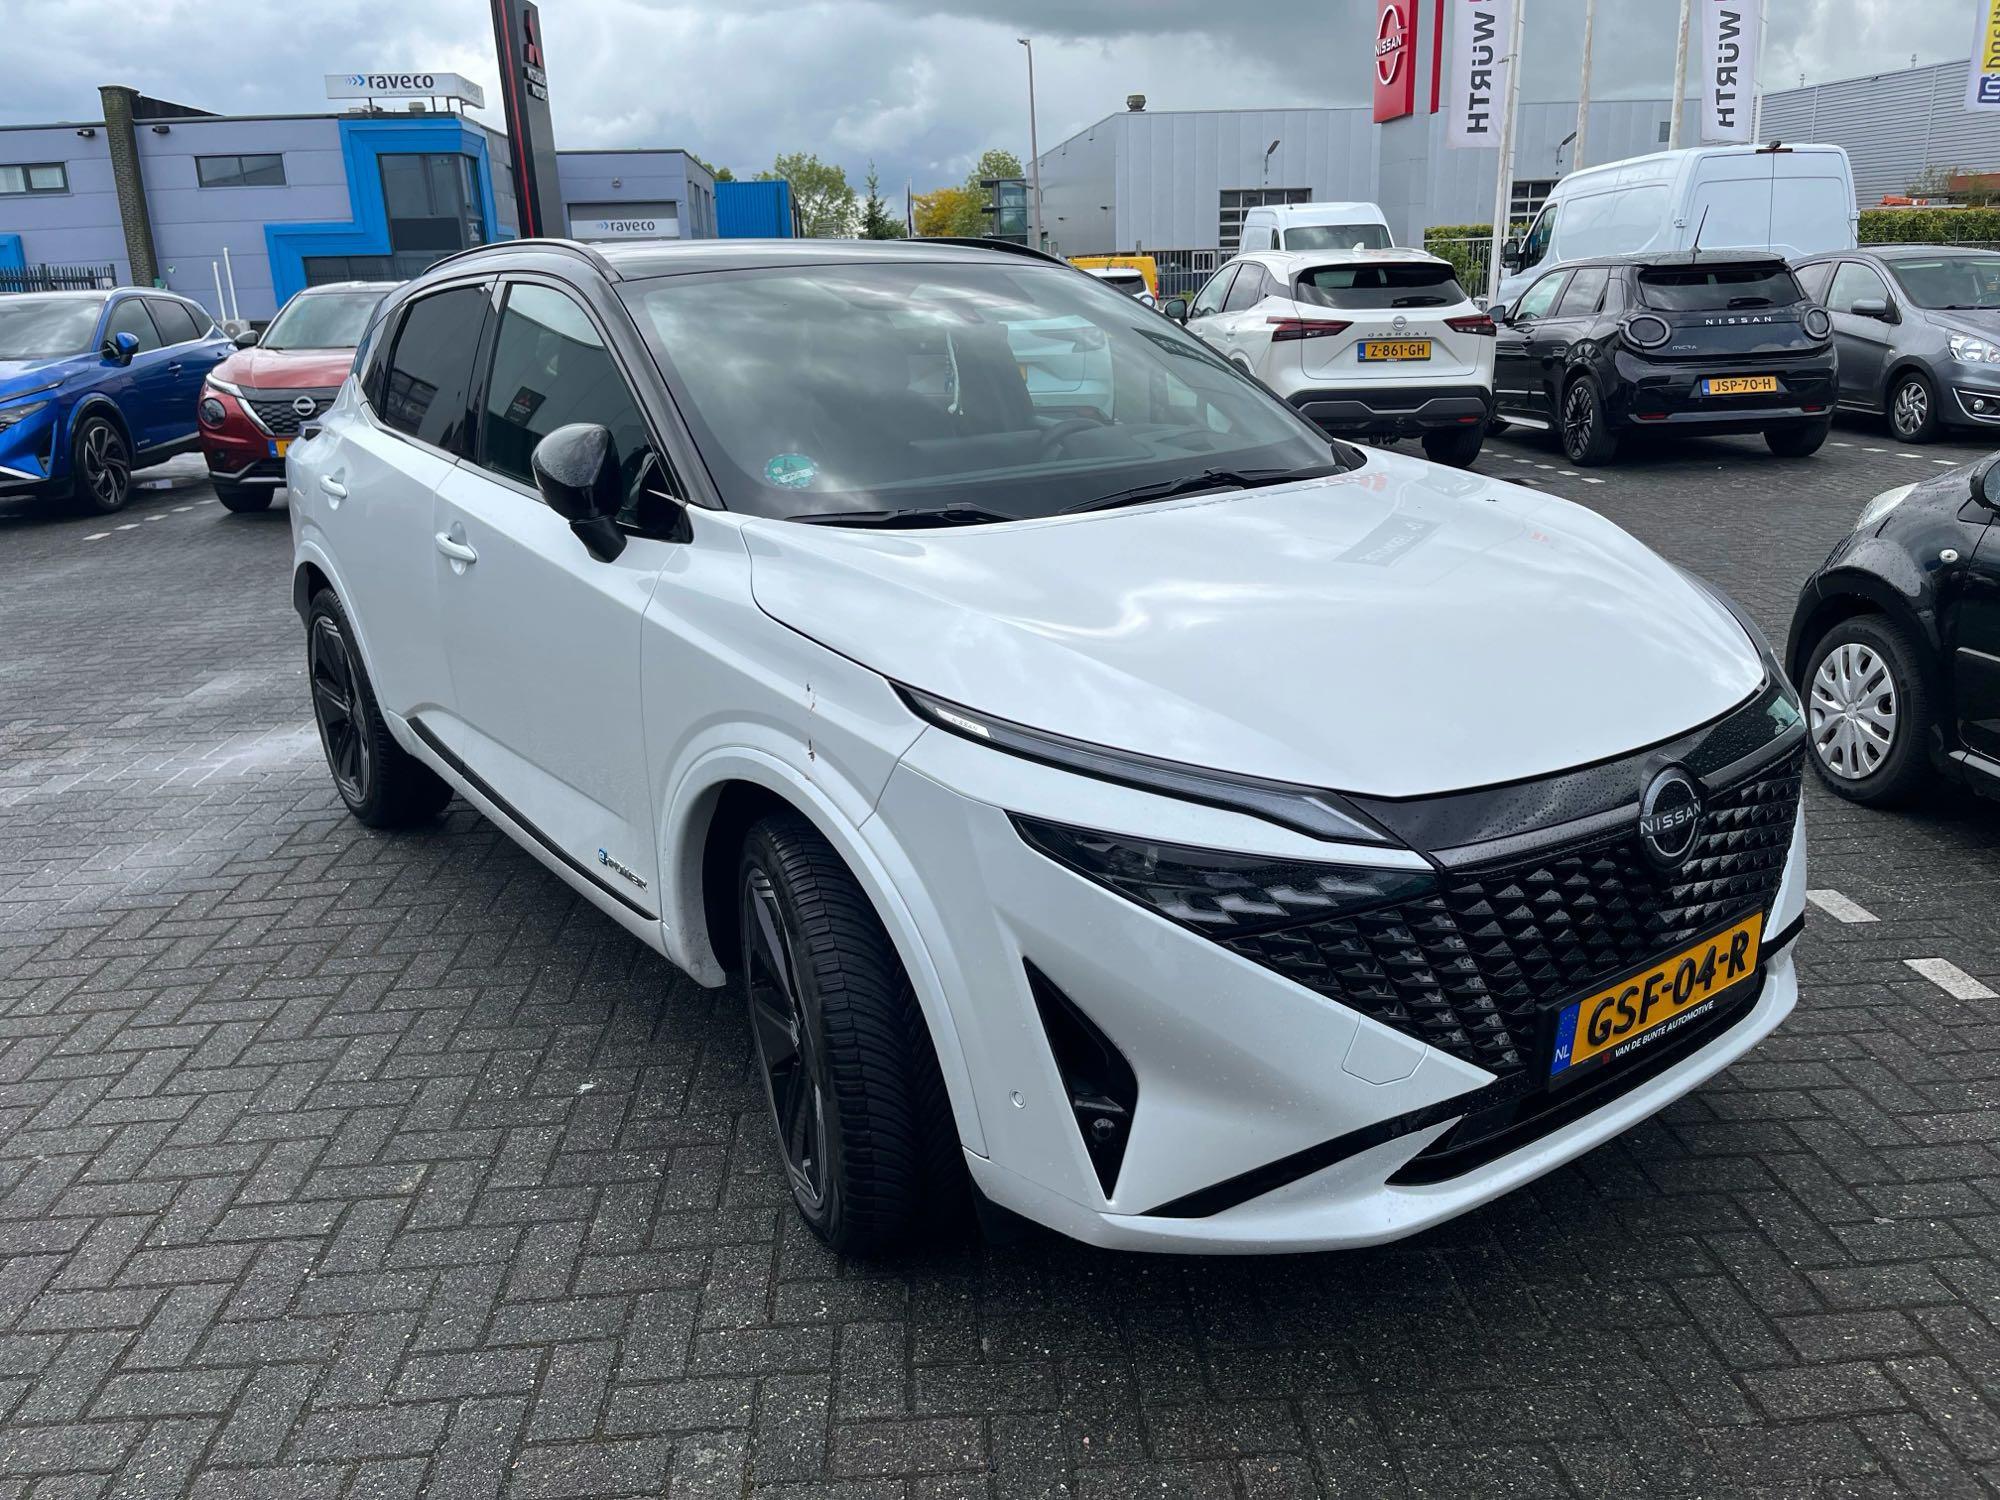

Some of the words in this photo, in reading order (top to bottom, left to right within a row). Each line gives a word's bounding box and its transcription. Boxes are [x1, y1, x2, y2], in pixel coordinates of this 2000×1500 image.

[1375, 34, 1402, 57] NISSAN
[368, 74, 434, 89] raveco
[610, 221, 656, 232] raveco
[1705, 316, 1772, 325] NISSAN
[1370, 344, 1425, 357] Z-861-GH
[1714, 378, 1771, 392] JSP-70-H
[1640, 799, 1701, 834] NISSAN
[1554, 1044, 1570, 1063] NL
[1586, 929, 1750, 1047] GSF-04-R
[1615, 1043, 1631, 1058] VAN
[1631, 1037, 1642, 1050] DE
[1642, 1025, 1667, 1045] BUNTE
[1666, 1000, 1714, 1032] AUTOMOTIVE
